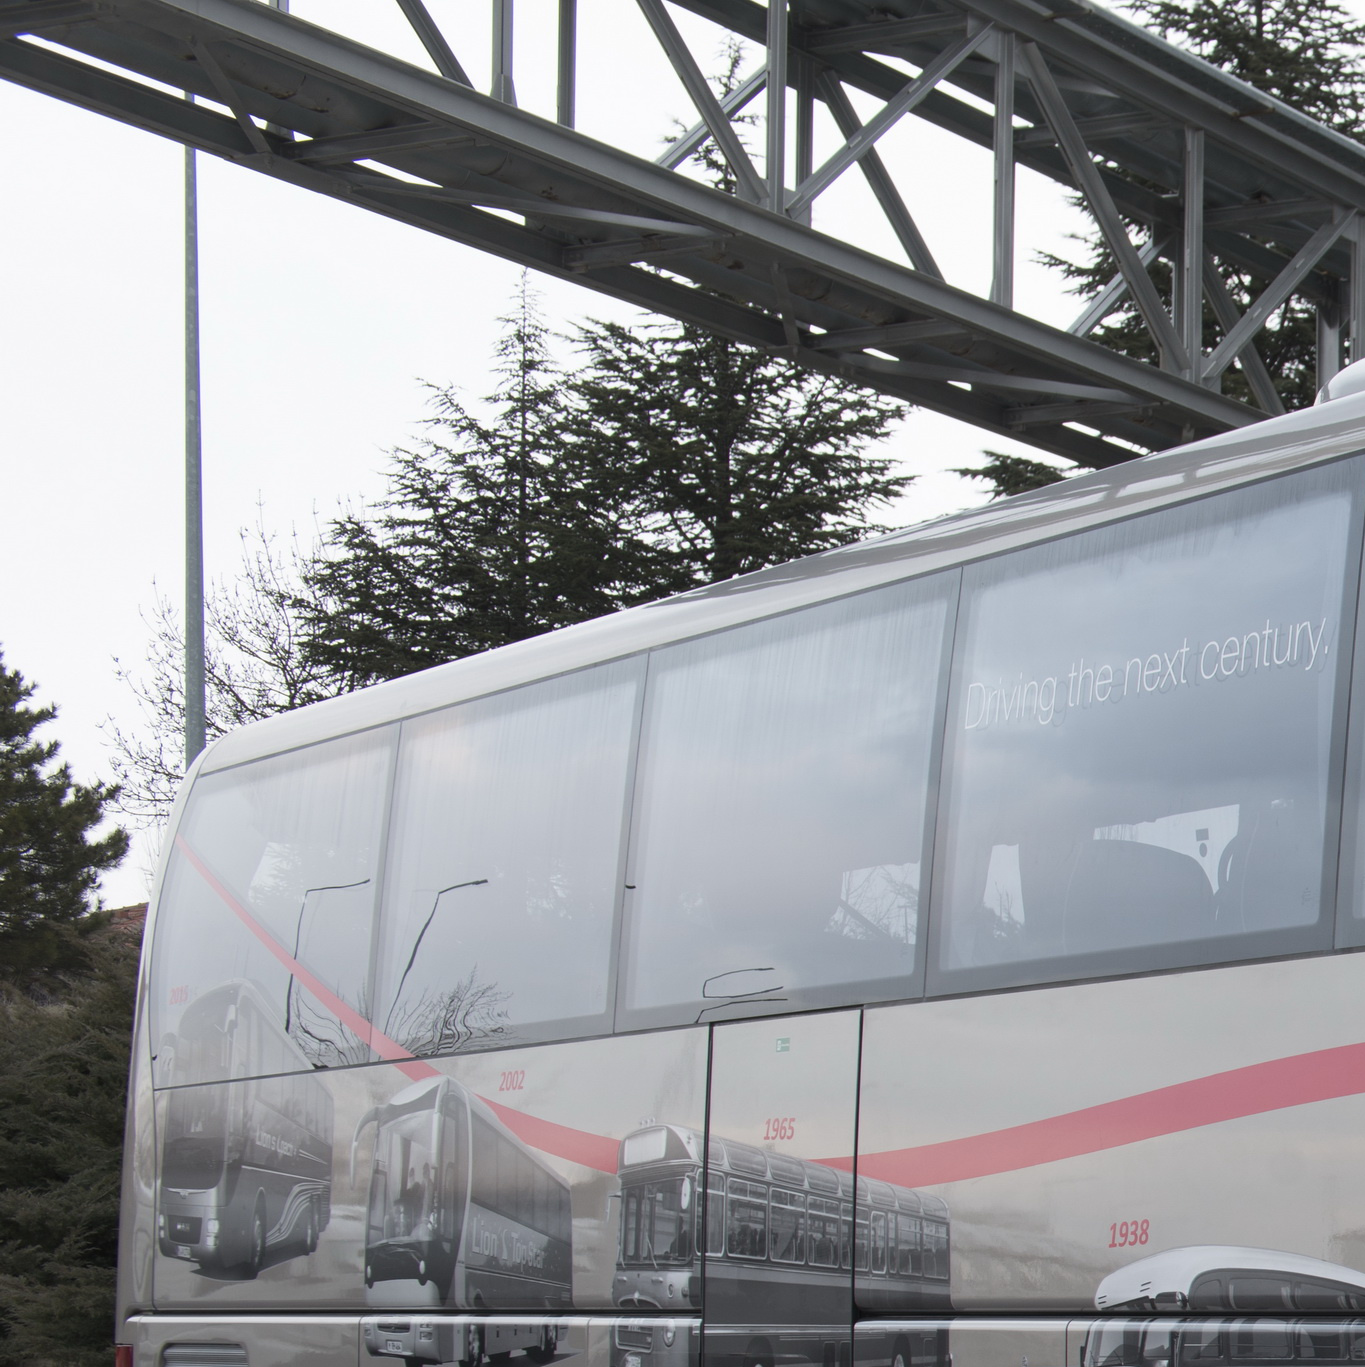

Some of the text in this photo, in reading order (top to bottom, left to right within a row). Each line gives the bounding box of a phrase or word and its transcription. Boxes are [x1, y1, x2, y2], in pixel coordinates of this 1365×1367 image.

[965, 617, 1329, 729] Driving the next century.
[499, 1070, 525, 1091] 2002
[763, 1117, 796, 1141] 1965
[1108, 1219, 1150, 1249] 1938
